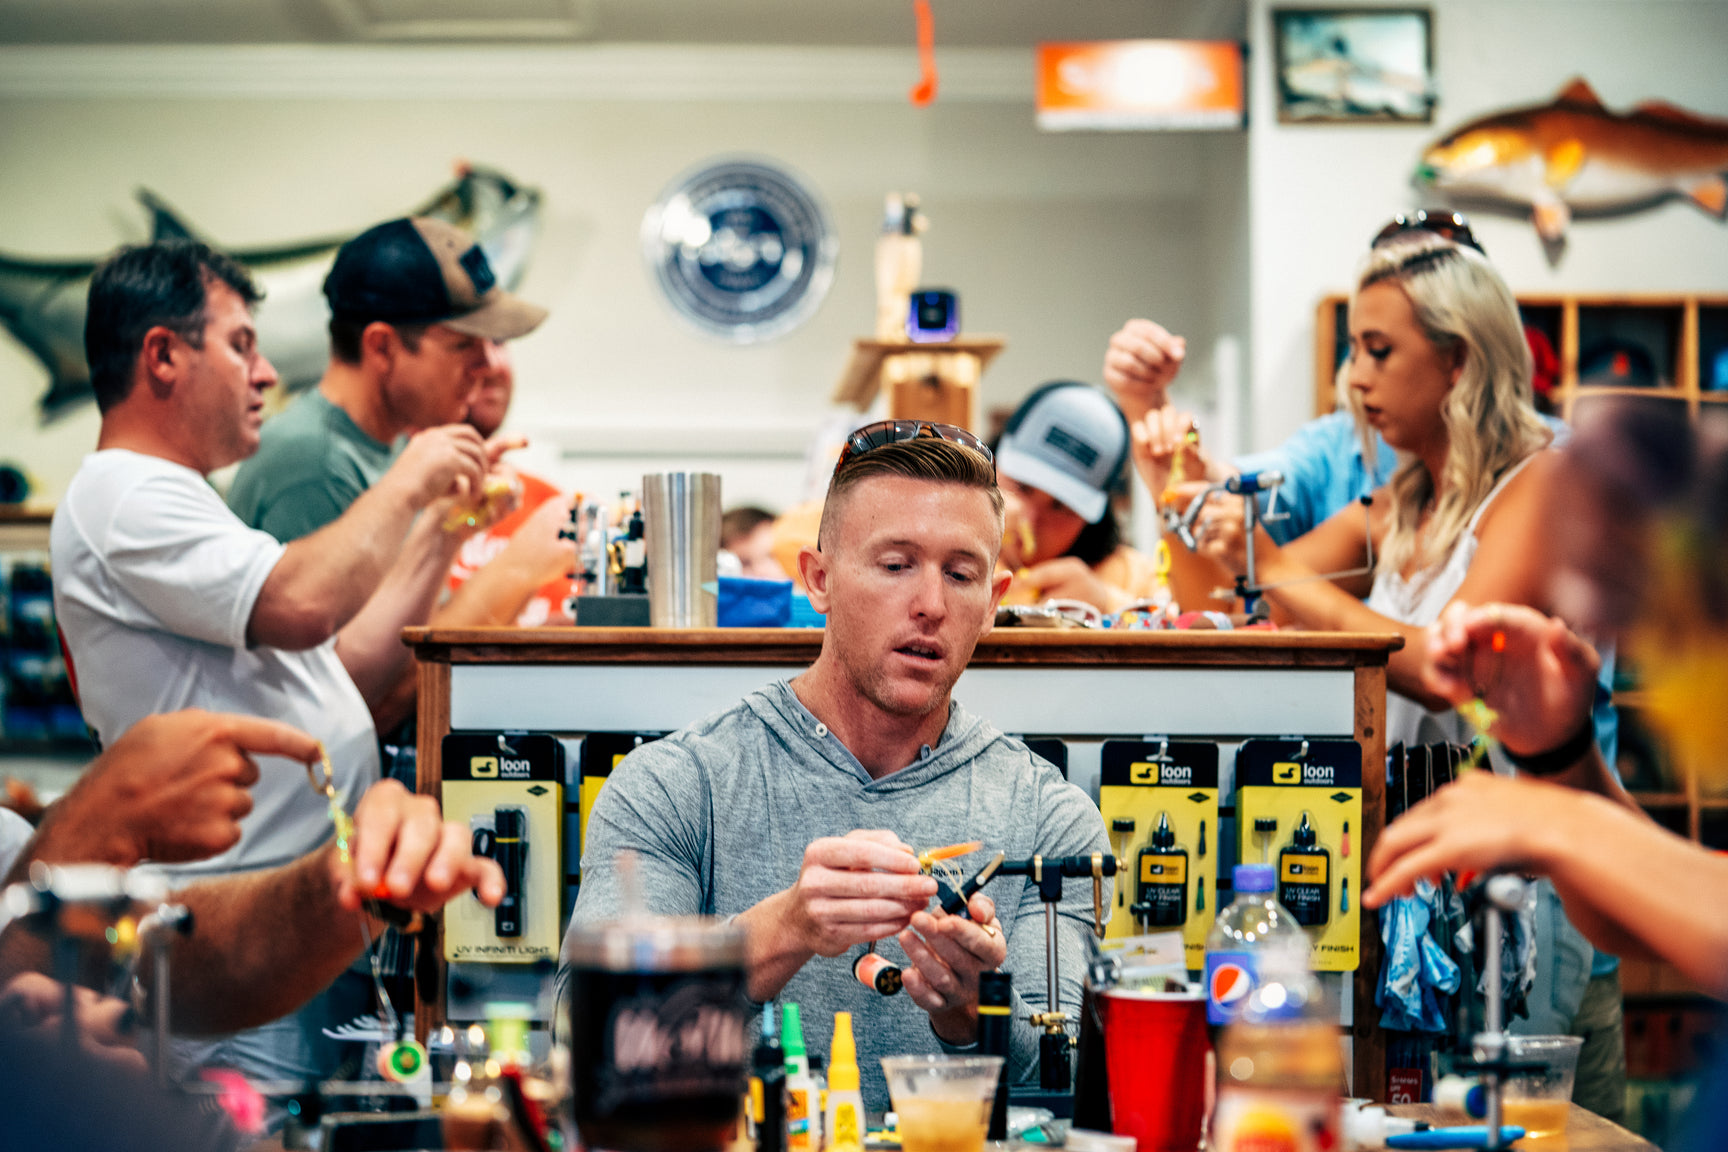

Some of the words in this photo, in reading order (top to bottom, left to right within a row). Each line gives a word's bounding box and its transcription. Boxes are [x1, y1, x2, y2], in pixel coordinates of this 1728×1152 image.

[500, 756, 531, 772] loon
[1161, 763, 1192, 778] loon
[1303, 763, 1334, 778] loon
[518, 946, 550, 954] LIGHT
[1321, 944, 1354, 952] FINISH
